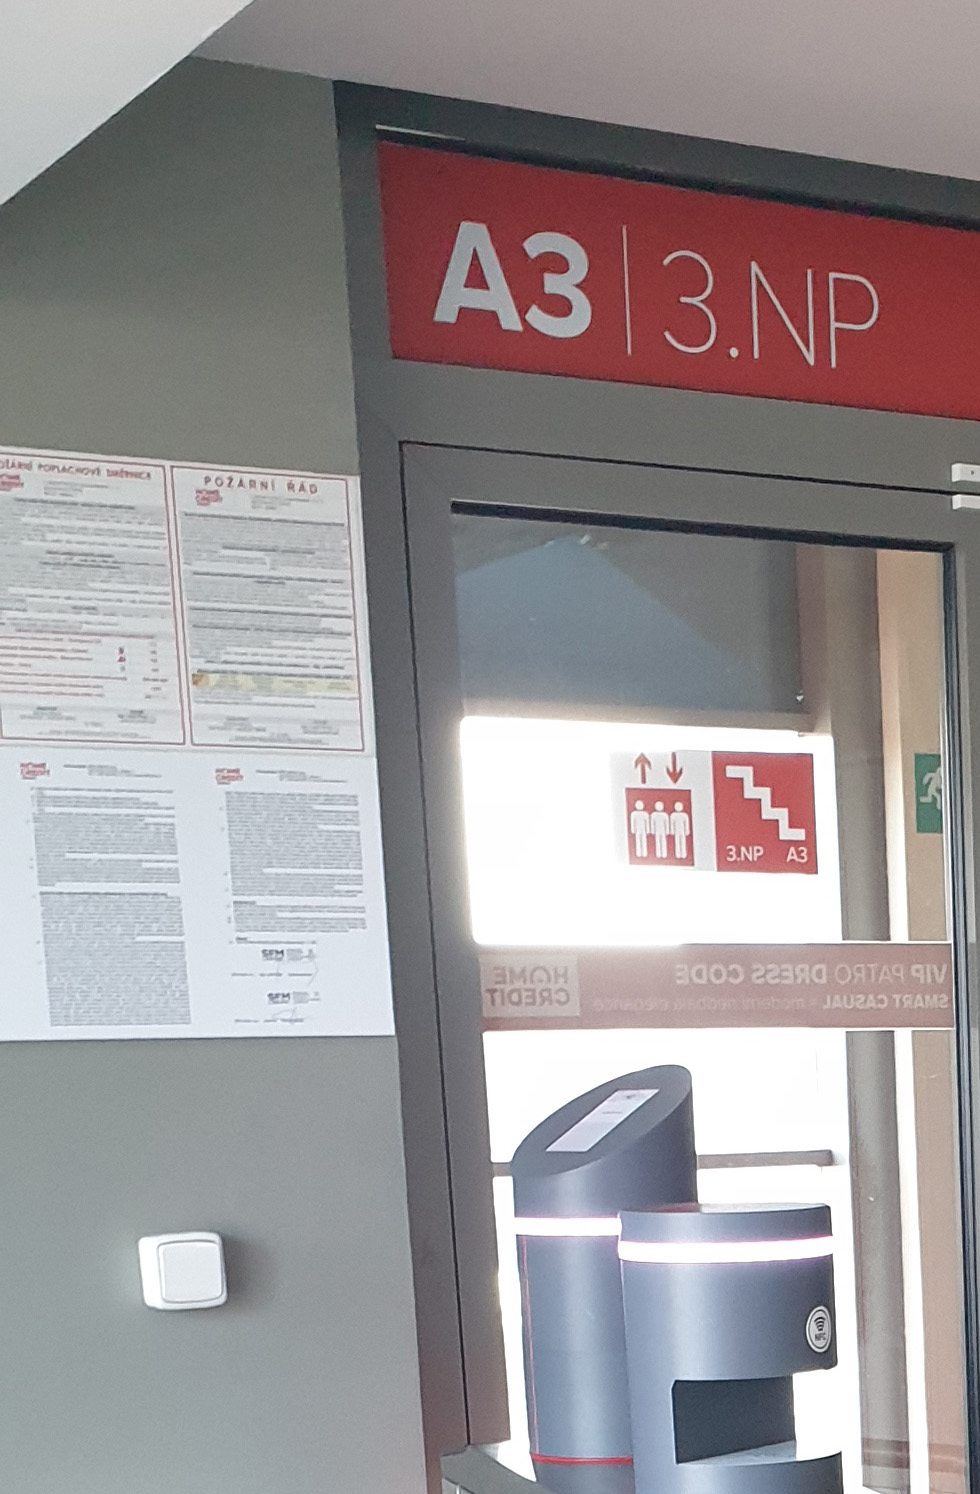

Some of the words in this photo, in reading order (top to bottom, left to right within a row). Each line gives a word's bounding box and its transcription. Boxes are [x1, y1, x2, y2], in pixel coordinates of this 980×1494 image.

[433, 220, 592, 339] A3
[663, 249, 879, 369] 3.NP
[726, 845, 764, 862] 3.NP
[786, 847, 808, 863] A3
